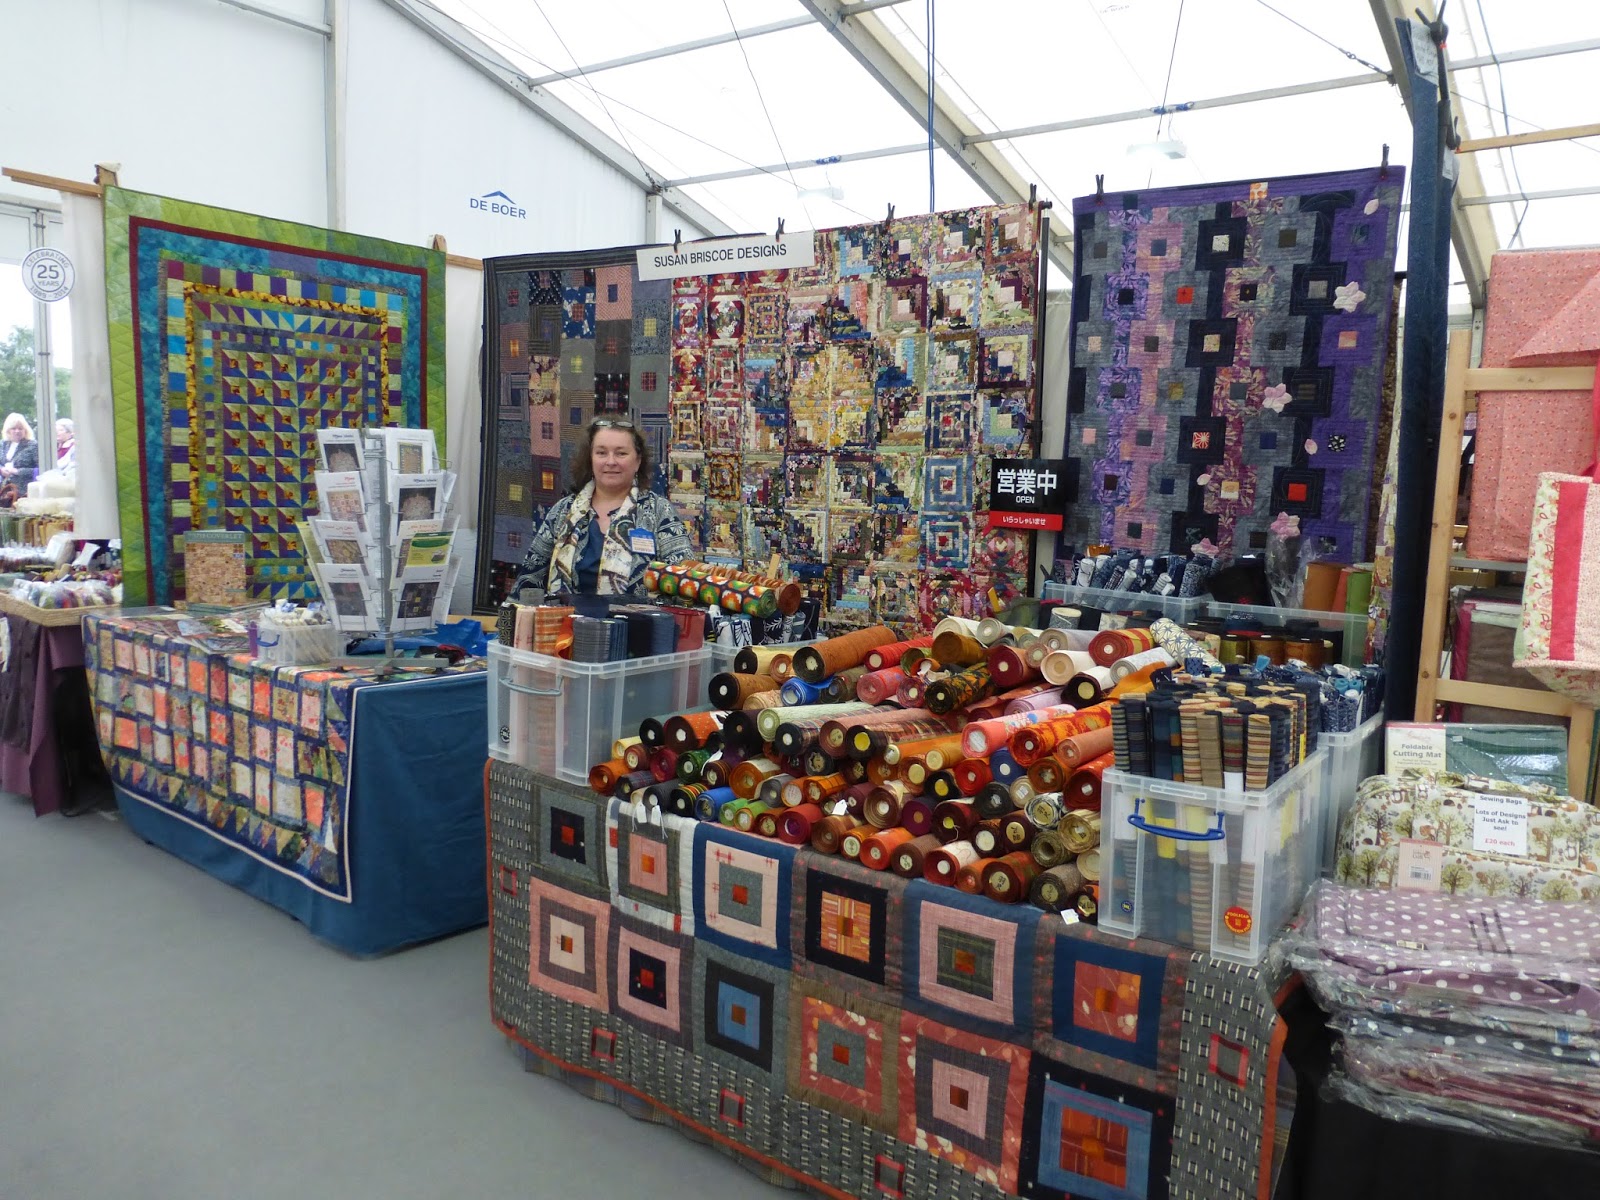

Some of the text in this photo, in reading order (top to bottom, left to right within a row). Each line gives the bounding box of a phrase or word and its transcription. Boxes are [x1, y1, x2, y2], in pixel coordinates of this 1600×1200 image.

[470, 198, 526, 219] DE BOER
[26, 251, 70, 268] CELEBRATING
[654, 243, 787, 268] SUSAN BRISCOE DESIGNS
[37, 264, 59, 279] 25
[997, 468, 1058, 496] 営業中
[1015, 495, 1035, 504] OPEN
[1002, 515, 1046, 526] いらっしゃいませ
[1393, 750, 1424, 759] Cutting
[1479, 795, 1523, 805] Sewing Bags
[1499, 811, 1526, 820] Designs
[1484, 837, 1498, 845] £20
